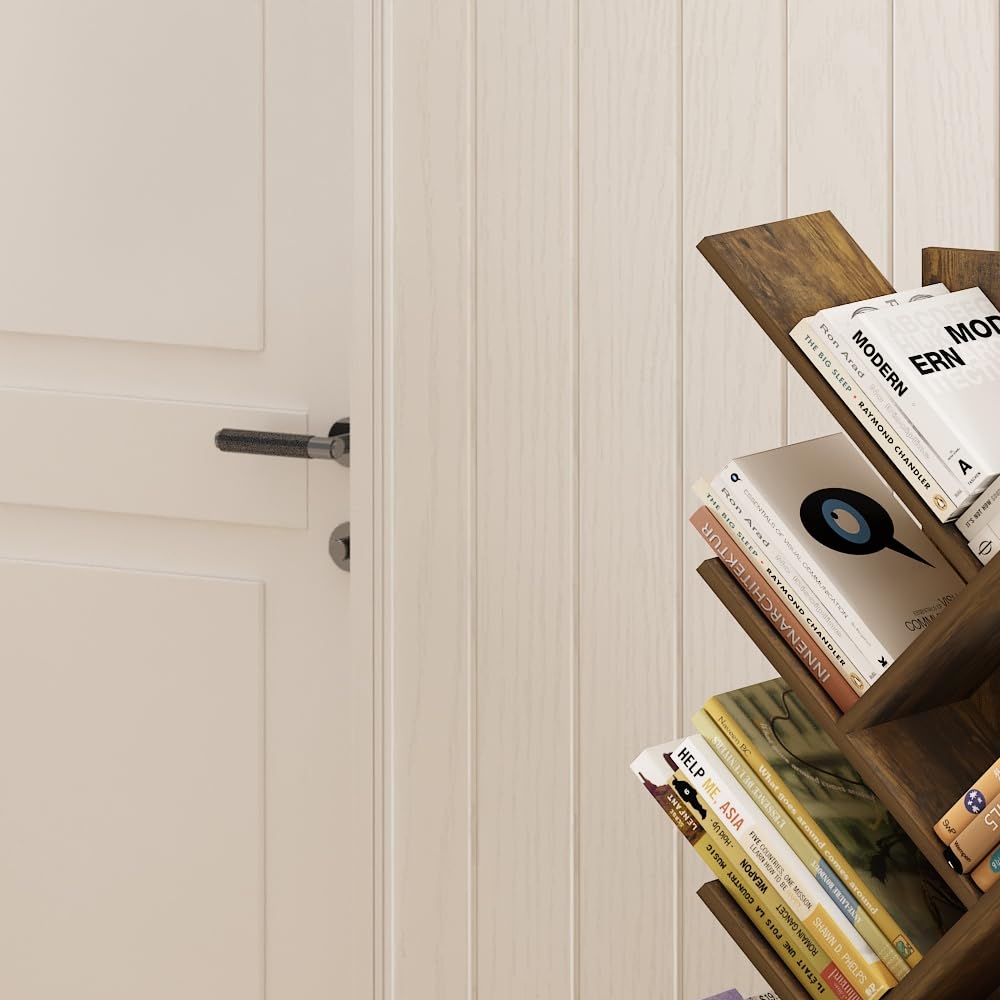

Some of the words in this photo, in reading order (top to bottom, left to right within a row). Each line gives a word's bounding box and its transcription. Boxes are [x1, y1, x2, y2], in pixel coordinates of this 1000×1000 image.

[819, 323, 839, 348] Ron
[840, 351, 865, 378] Arad
[852, 329, 908, 397] MODERN
[908, 347, 966, 375] ERN
[804, 334, 818, 352] THE
[818, 352, 832, 368] BIG
[832, 368, 852, 392] SLEEP
[858, 401, 894, 444] RAYMOND
[894, 446, 931, 490] CHANDLER
[958, 459, 973, 475] A
[721, 487, 742, 514] Ron
[744, 518, 770, 547] Arad
[982, 500, 992, 510] HOW
[706, 493, 720, 511] THE
[721, 512, 736, 529] BIG
[737, 531, 758, 556] SLEEP
[766, 568, 805, 615] RAYMOND
[806, 618, 846, 666] CHANDLER
[802, 562, 848, 619] COMMUNICATION
[701, 522, 831, 683] INNENARCHITEKTUR
[677, 747, 705, 778] HELP
[701, 777, 721, 804] ME,
[719, 801, 745, 831] ASIA
[711, 821, 723, 834] Up
[717, 716, 740, 746] Naveen
[758, 764, 779, 791] What
[778, 792, 798, 816] goes
[797, 815, 826, 849] around
[824, 849, 849, 881] comes
[849, 880, 879, 915] around
[719, 830, 731, 847] Hold
[953, 840, 972, 863] Wempen
[706, 844, 728, 870] MUSIC
[749, 830, 762, 846] FIVE
[760, 844, 785, 875] COUNTRIES,
[783, 874, 795, 887] ONE
[749, 844, 765, 864] LEARN
[763, 861, 776, 876] HOW
[774, 873, 782, 884] TO
[780, 881, 789, 891] BE
[727, 871, 755, 905] COUNTRY
[739, 858, 769, 895] WEAPON
[755, 905, 766, 918] LA
[775, 904, 799, 931] GANCET
[765, 919, 784, 940] FOIS
[798, 931, 819, 957] ROMAIN
[782, 941, 797, 958] UNE
[812, 917, 838, 947] SHAWN
[841, 952, 867, 984] PHELPS
[796, 960, 817, 985] ÉTAIT
[815, 984, 826, 995] IL
